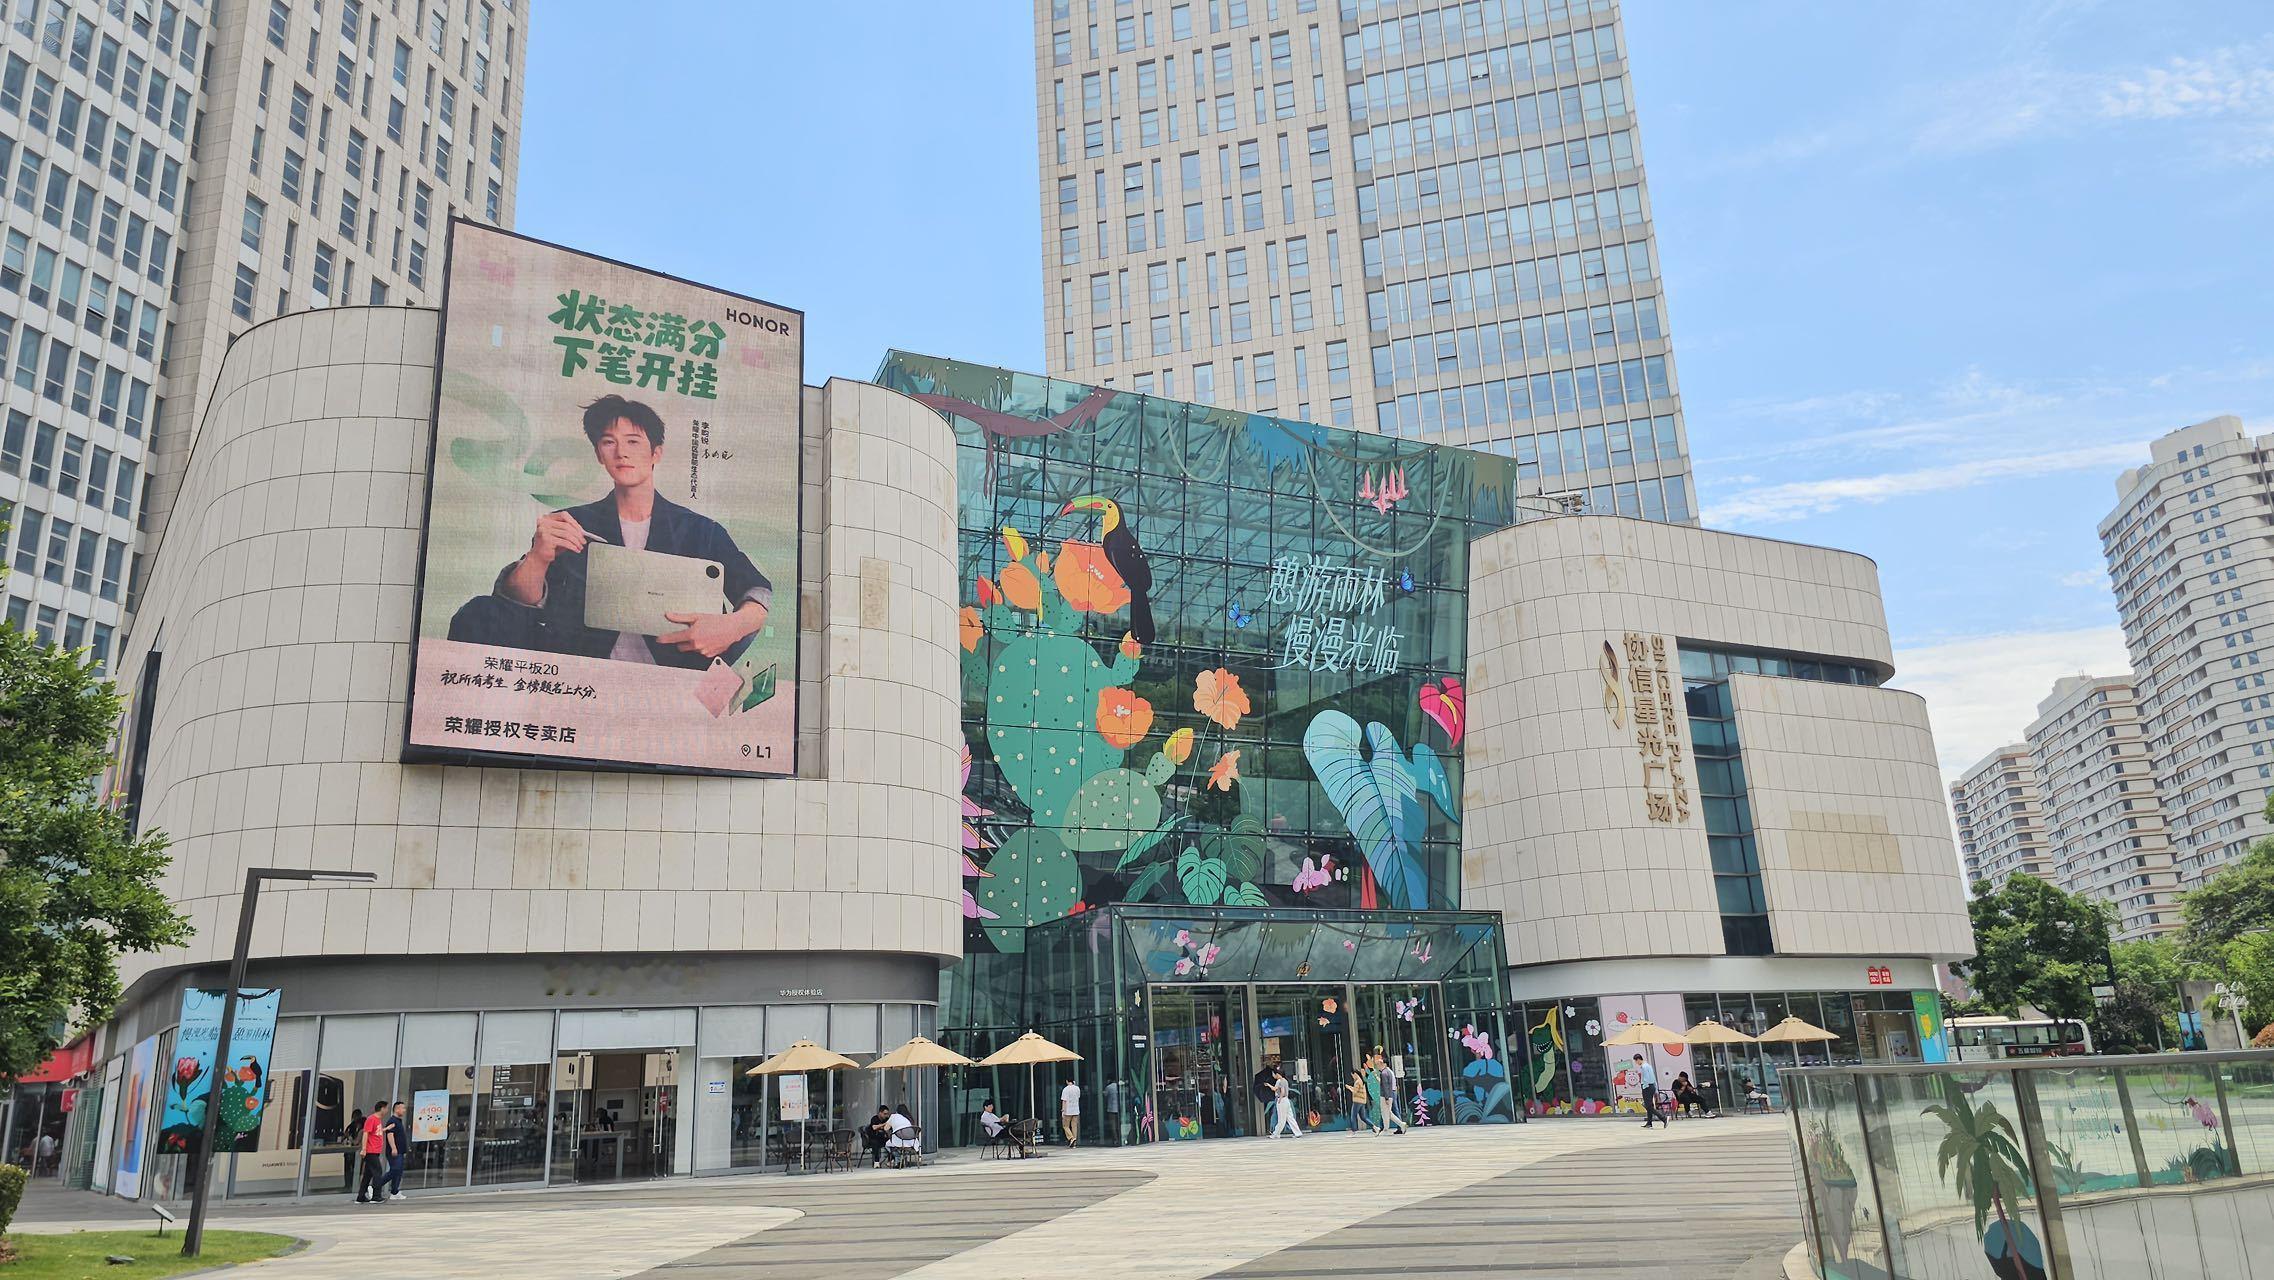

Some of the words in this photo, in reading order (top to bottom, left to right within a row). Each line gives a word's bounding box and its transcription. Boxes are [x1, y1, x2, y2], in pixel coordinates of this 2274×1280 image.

[547, 289, 727, 361] 状态满分
[726, 307, 791, 337] HONOR
[552, 336, 719, 400] 下笔开挂
[1265, 553, 1391, 617] 憩游雨林
[441, 669, 508, 689] 祝所有考生
[484, 656, 560, 676] 荣耀平板20
[444, 715, 578, 744] 荣耀授权专卖店
[1623, 633, 1673, 823] 协信星光广场
[1651, 634, 1679, 737] SINCERE
[1667, 740, 1691, 824] PLAZA
[755, 745, 772, 759] L1
